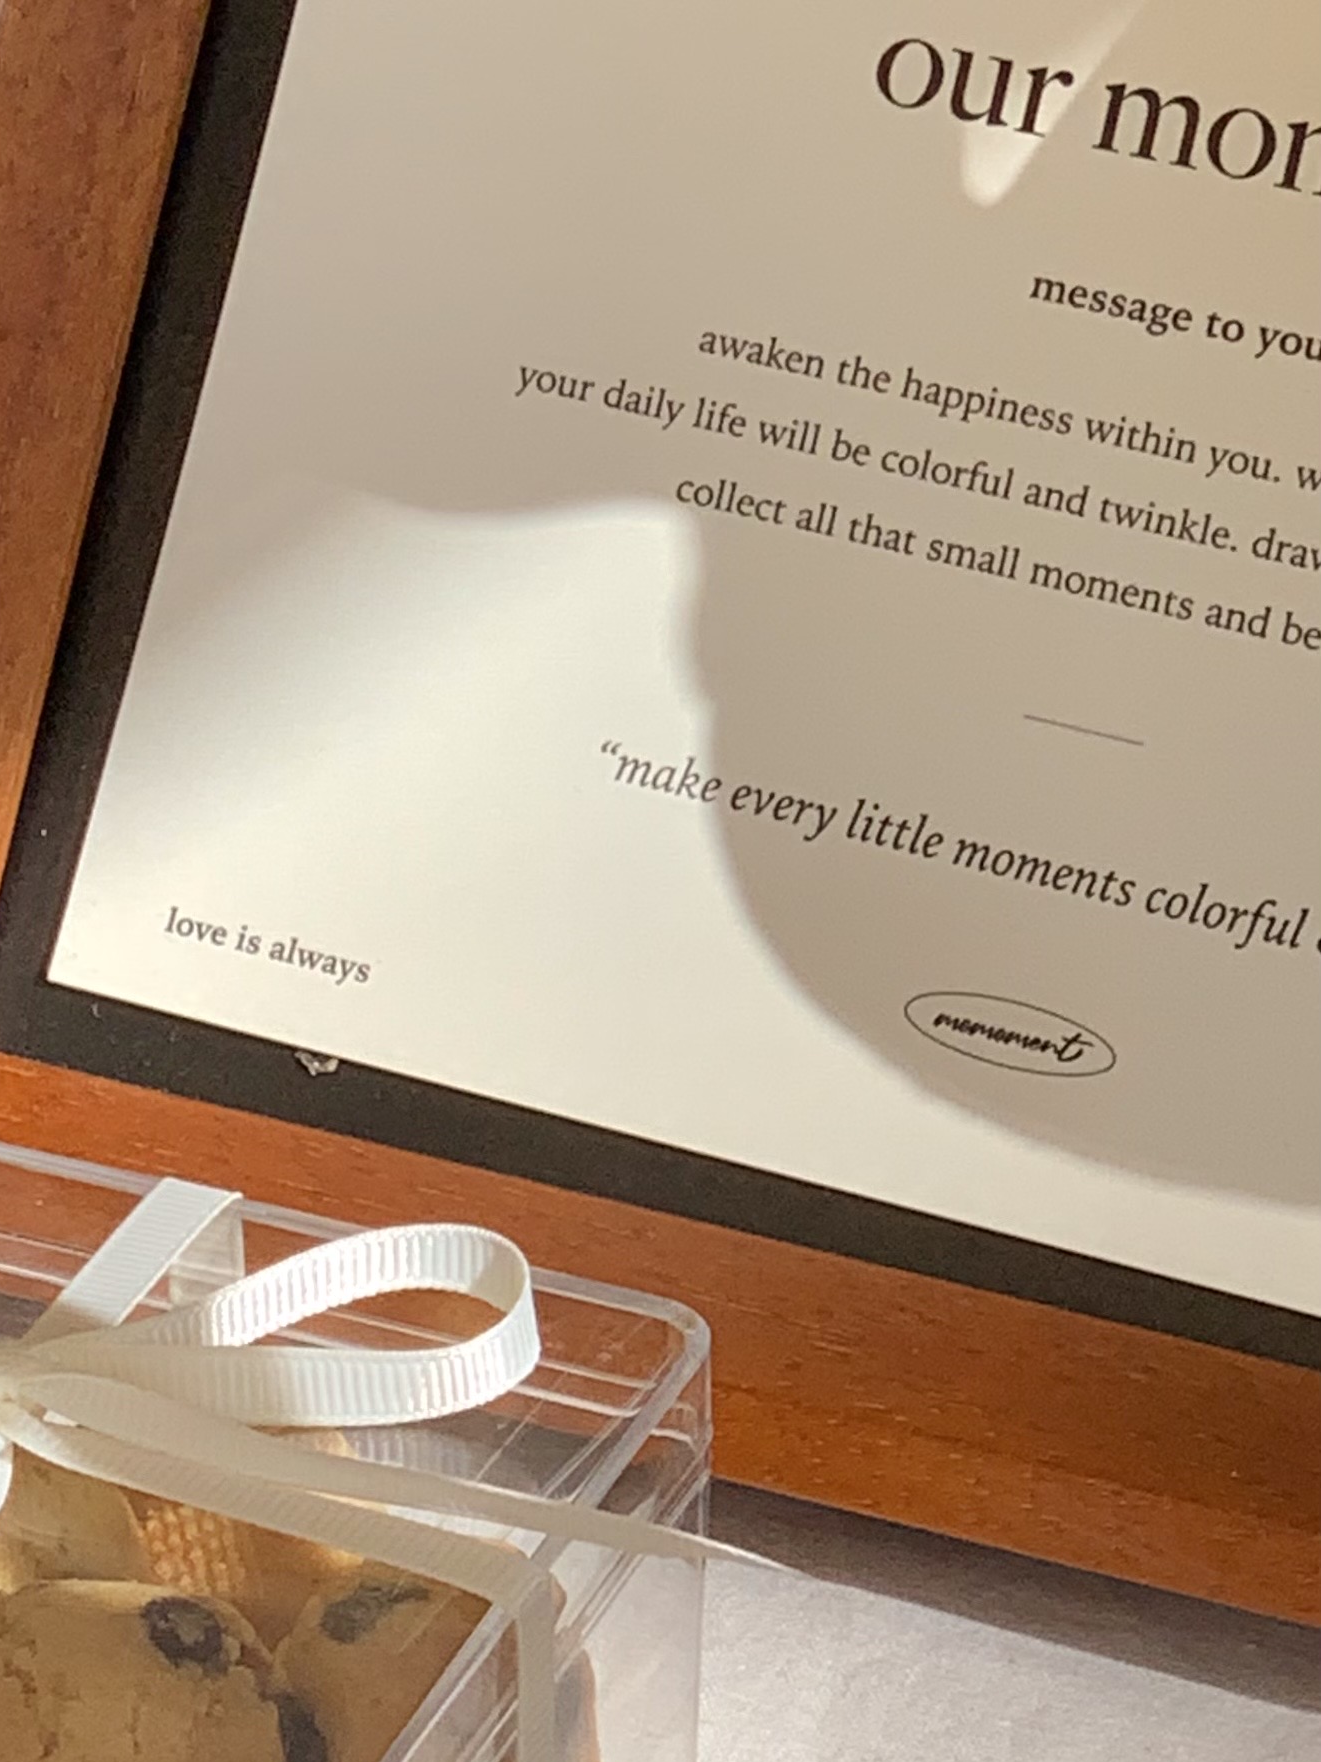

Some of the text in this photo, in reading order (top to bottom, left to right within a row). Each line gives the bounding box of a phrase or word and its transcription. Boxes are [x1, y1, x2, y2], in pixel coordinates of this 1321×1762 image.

[876, 38, 1074, 137] our
[1029, 277, 1193, 337] message
[1206, 312, 1245, 343] to
[515, 366, 596, 402] your
[603, 378, 686, 431] daily
[692, 396, 747, 438] life
[759, 419, 822, 455] will
[831, 428, 871, 467] be
[880, 448, 1015, 500] colorful
[1023, 483, 1091, 518] and
[1099, 497, 1237, 553] twinkle.
[698, 331, 825, 380] awaken
[837, 355, 892, 394] the
[900, 366, 1073, 435] happiness
[1085, 415, 1196, 464] within
[1205, 446, 1280, 483] you.
[675, 479, 787, 525] collect
[795, 502, 838, 537] all
[848, 513, 917, 556] that
[926, 539, 1021, 580] small
[1029, 562, 1194, 621] moments
[1204, 604, 1272, 639] and
[729, 785, 838, 842] every
[846, 798, 944, 859] little
[952, 838, 1137, 907] moments
[1145, 883, 1310, 949] colorful
[164, 905, 371, 985] love is always
